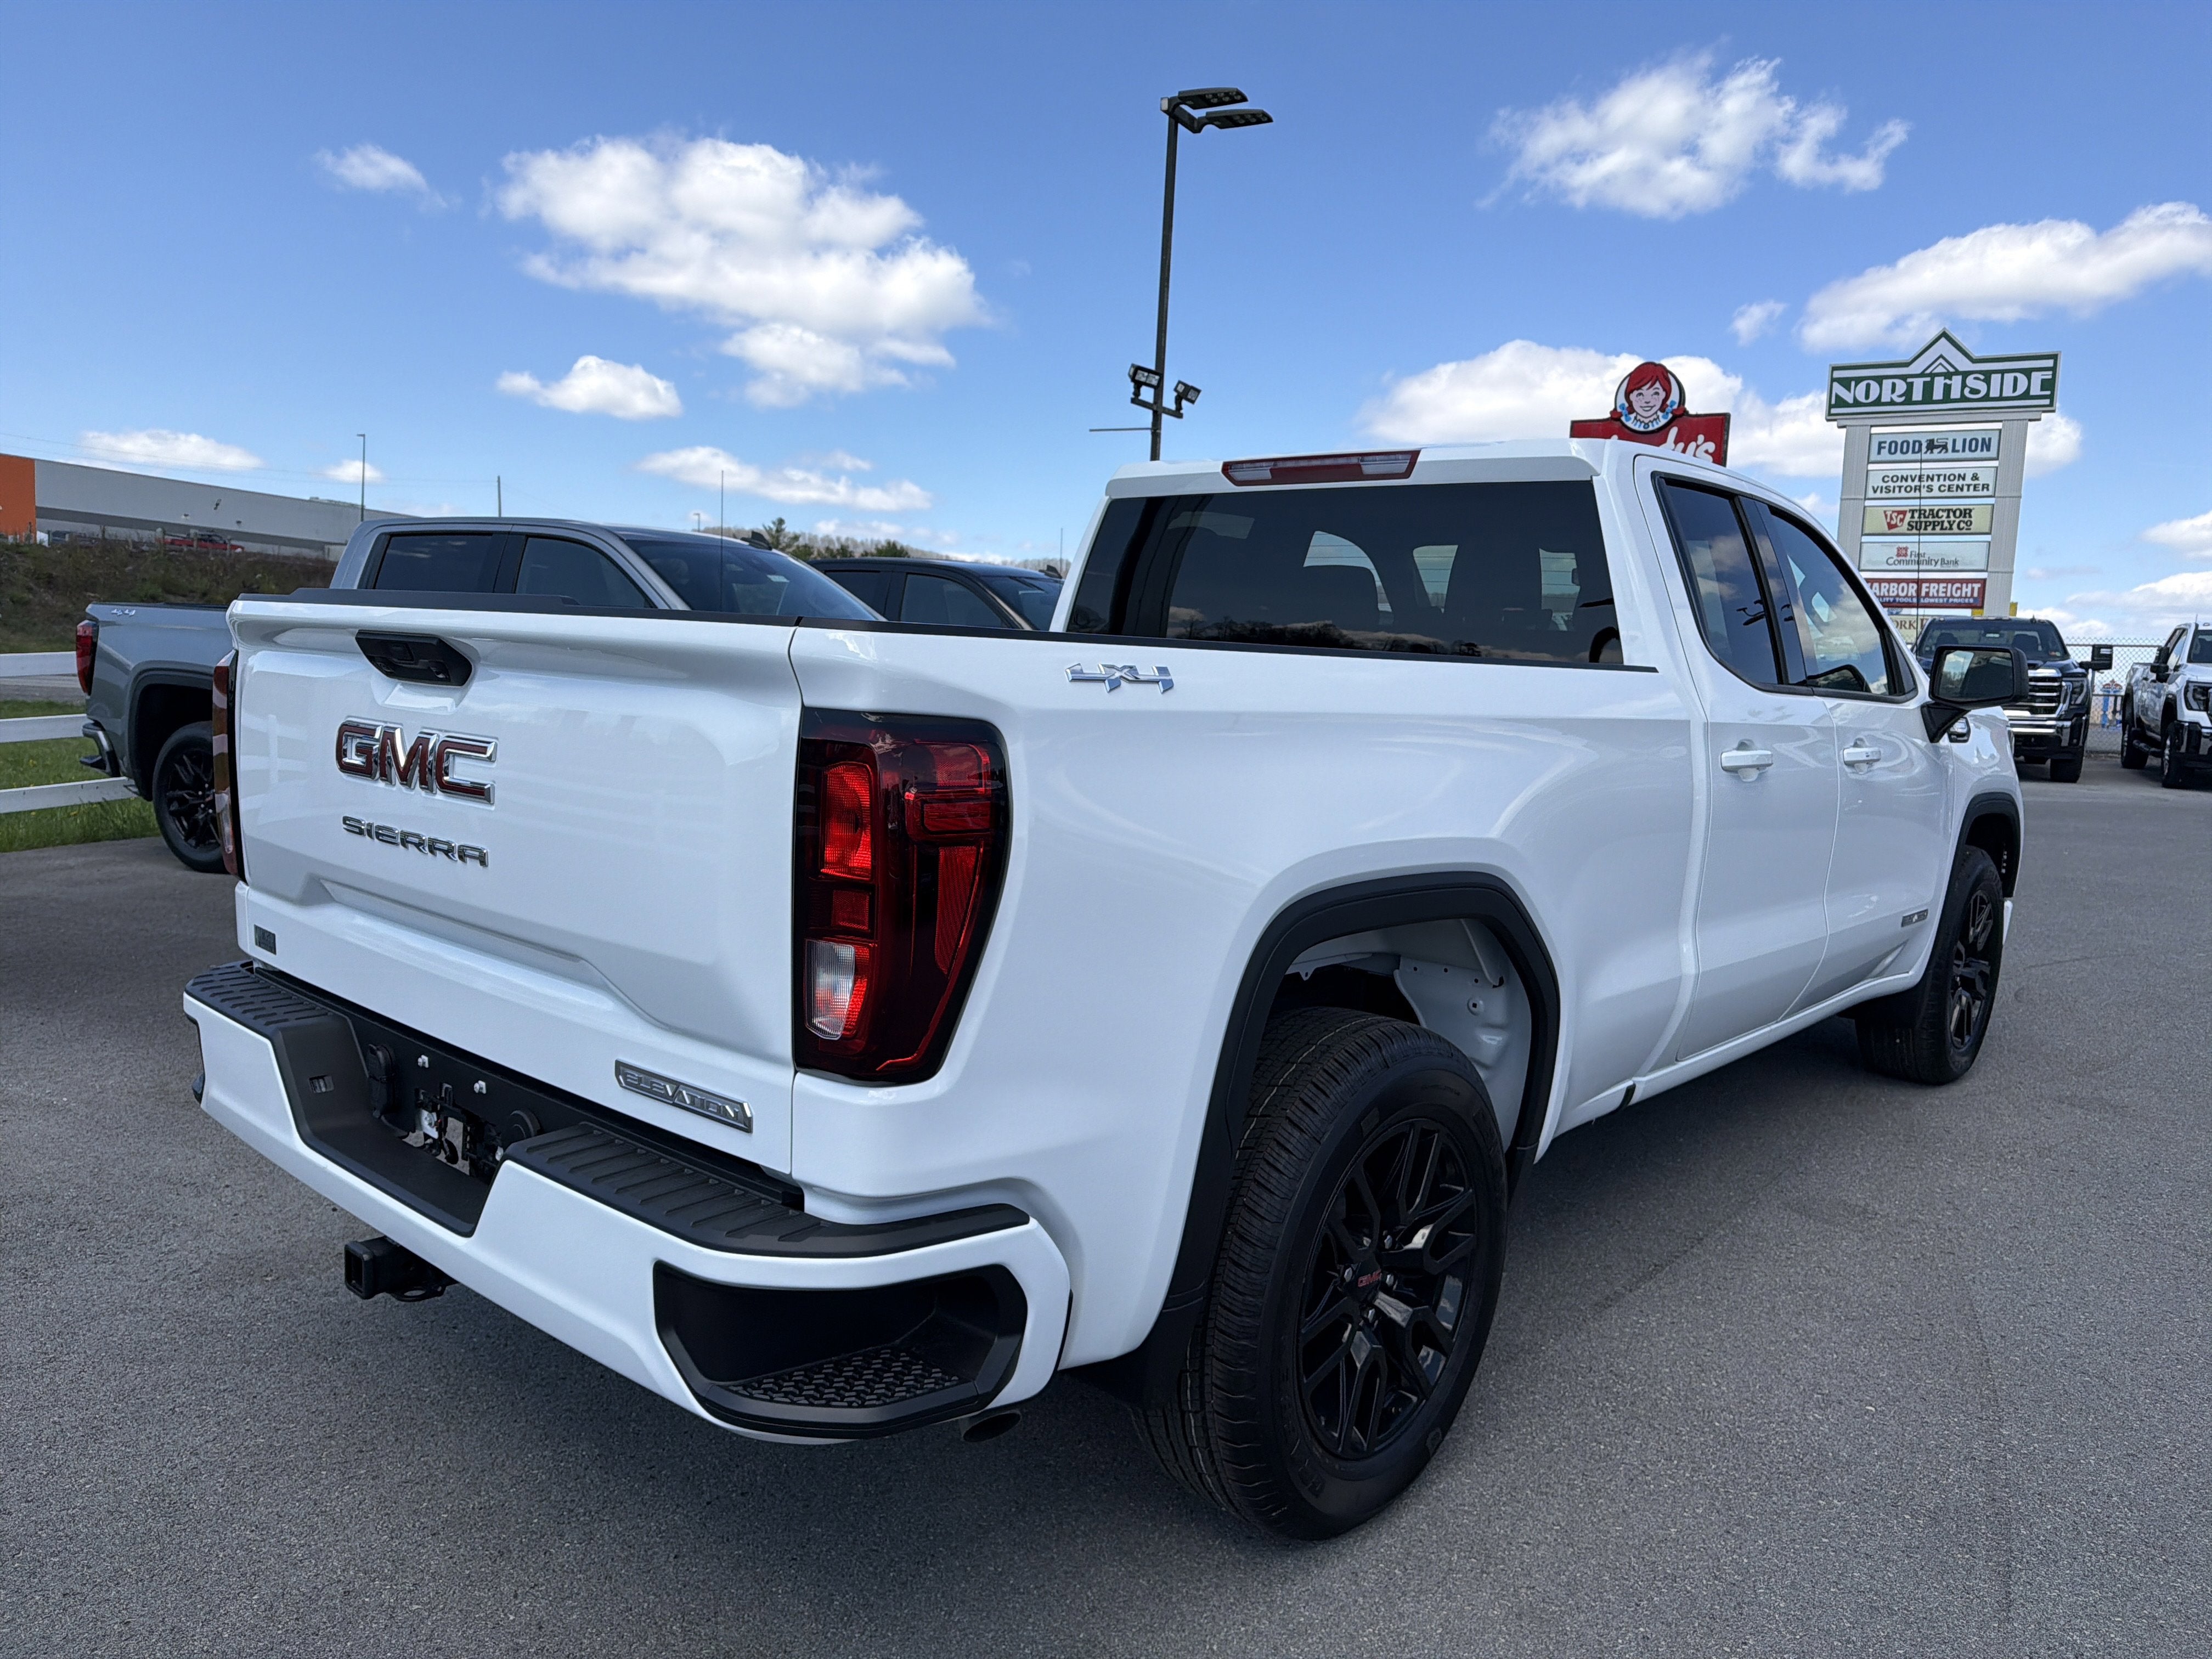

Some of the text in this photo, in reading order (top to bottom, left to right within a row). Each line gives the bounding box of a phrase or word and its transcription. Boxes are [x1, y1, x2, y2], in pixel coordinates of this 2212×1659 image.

[1831, 370, 2053, 404] NORTHSIDE
[1876, 437, 1992, 455] FOOD LION
[1881, 472, 1980, 483] CONVENTION &
[1871, 483, 1990, 494] VISITOR'S CENTER
[1886, 511, 1904, 527] TSC
[1909, 508, 1973, 520] TRACTOR
[1906, 520, 1956, 531] SUPPLY
[1886, 556, 1960, 567] Community Bank
[1868, 582, 1982, 597] ARBOR FREIGHT
[335, 718, 498, 806] GMC
[342, 815, 489, 868] SIERRA
[625, 1071, 740, 1124] ELEVATION
